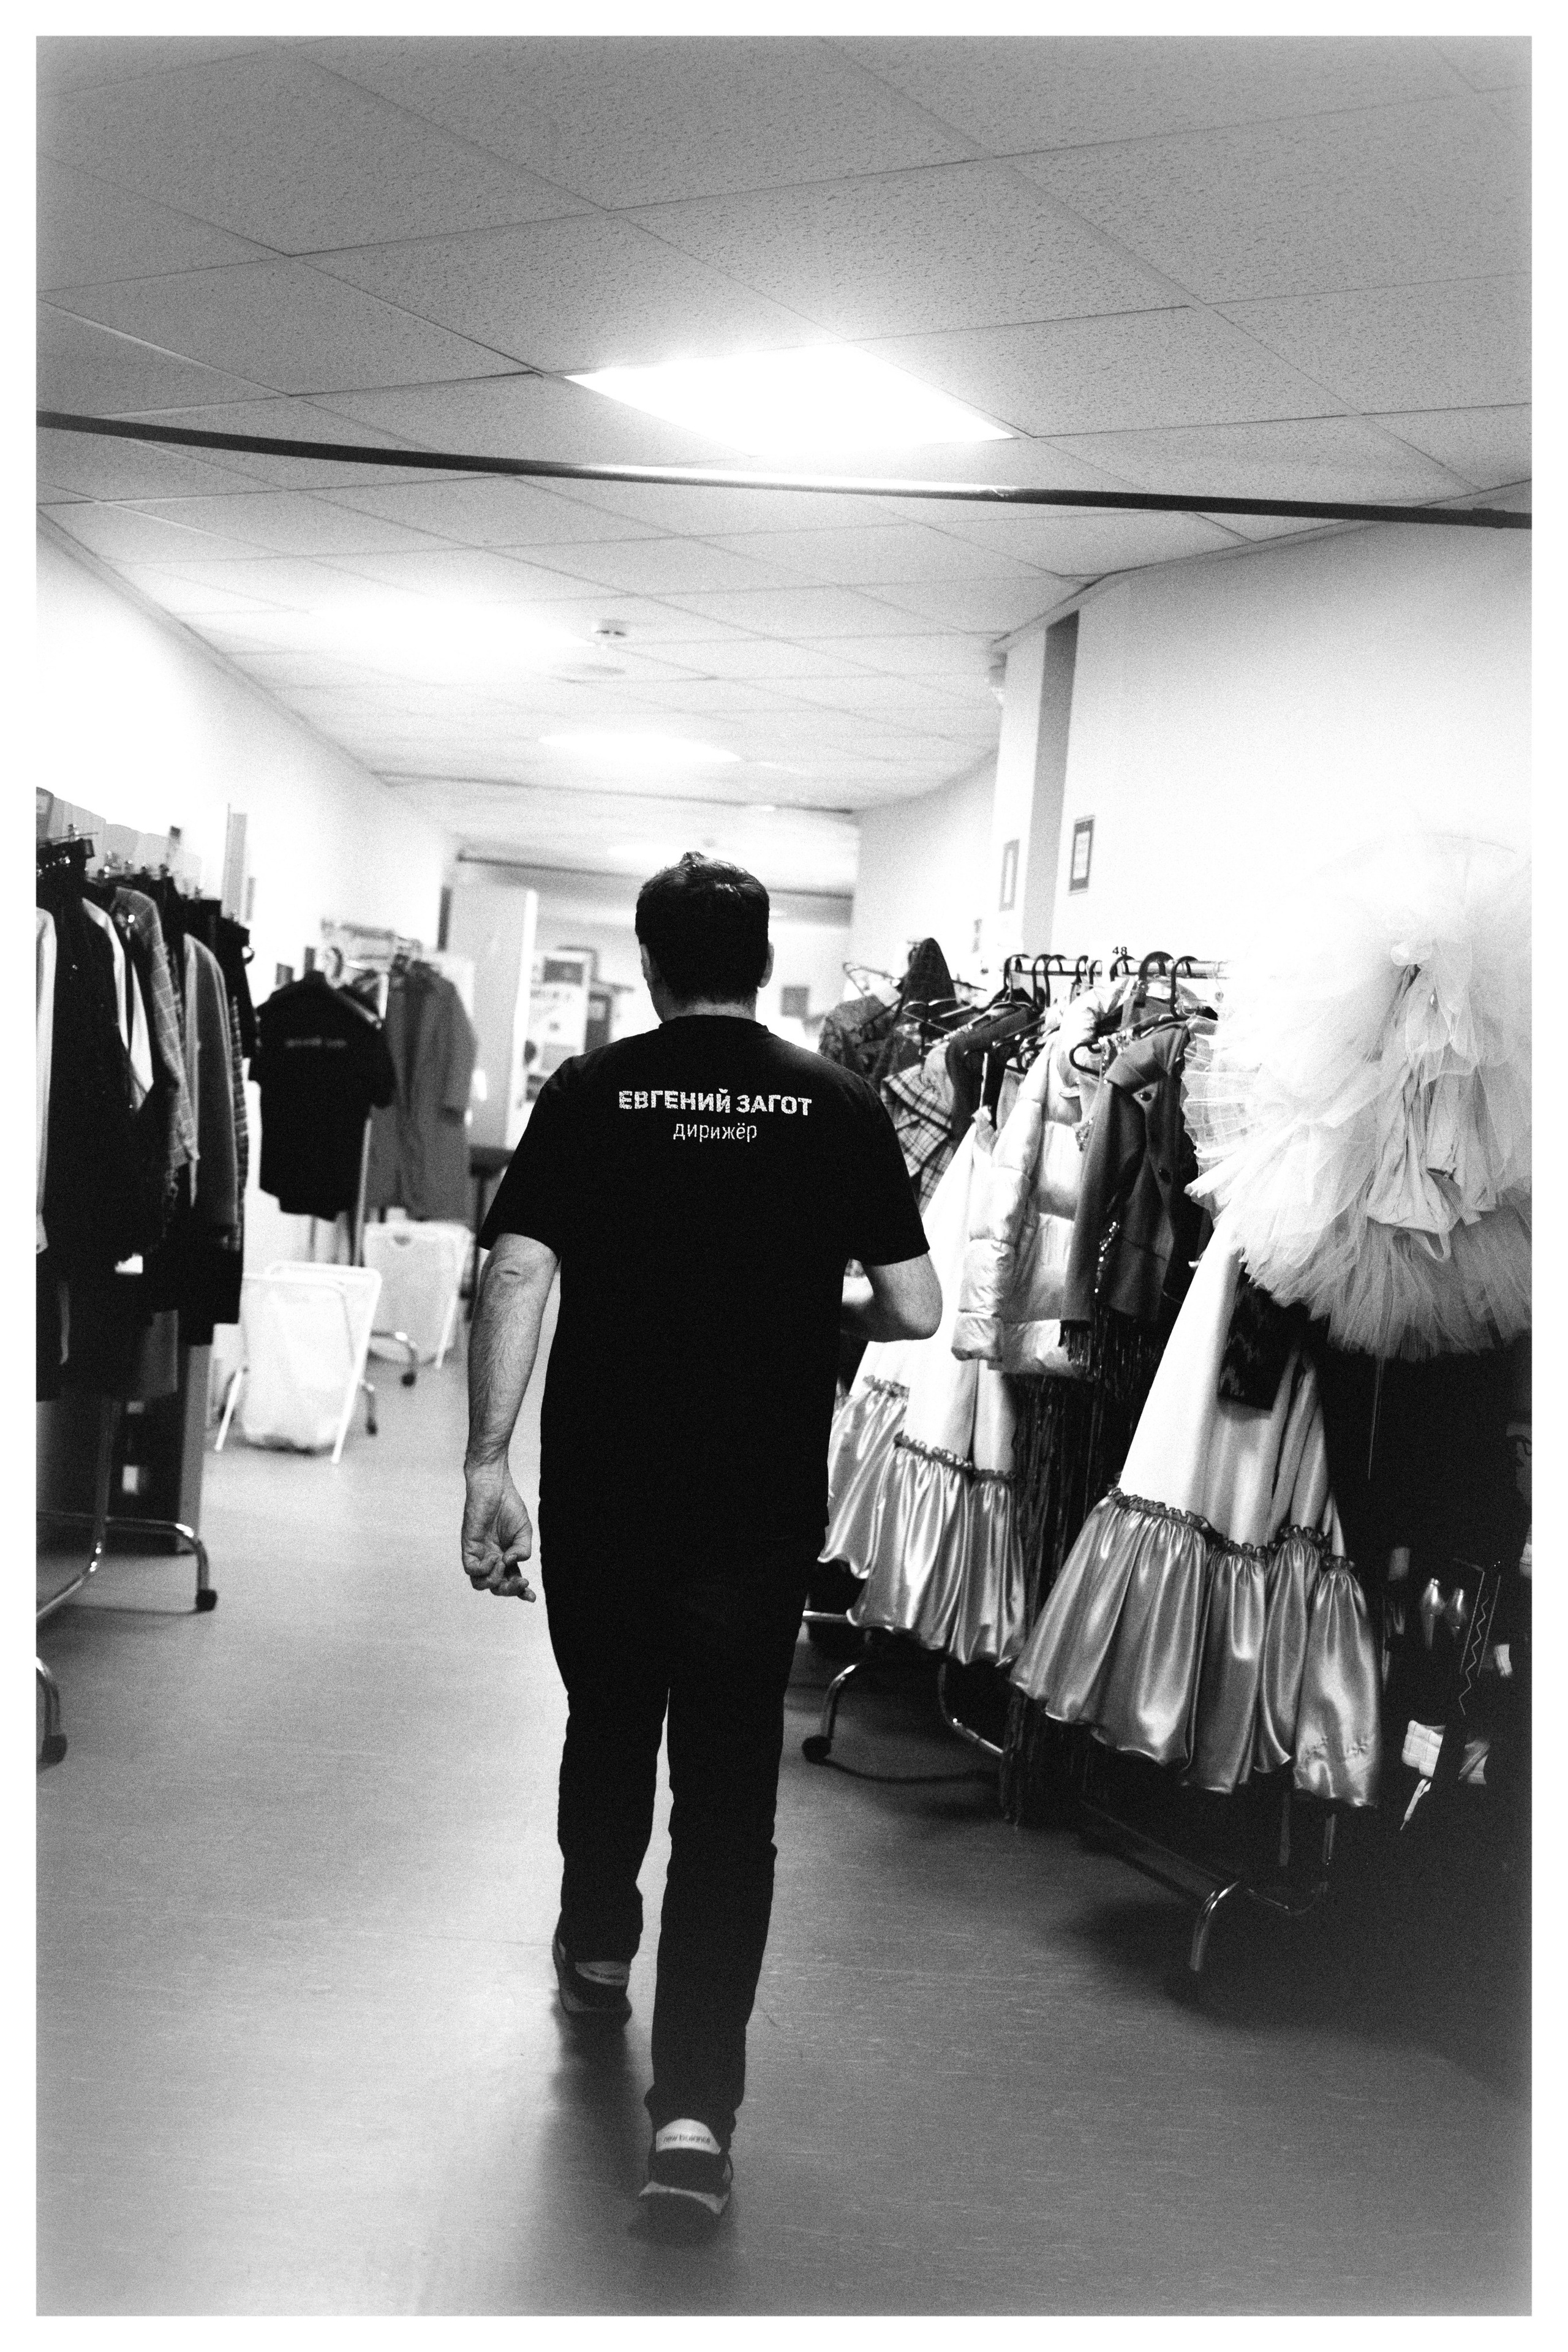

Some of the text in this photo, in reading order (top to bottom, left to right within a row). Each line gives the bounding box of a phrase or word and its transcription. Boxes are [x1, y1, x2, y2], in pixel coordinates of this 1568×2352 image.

[1112, 946, 1128, 956] 48
[619, 1088, 812, 1116] ЕВГЕНИЙ ЗАГОТ
[673, 1122, 758, 1143] дирижёр
